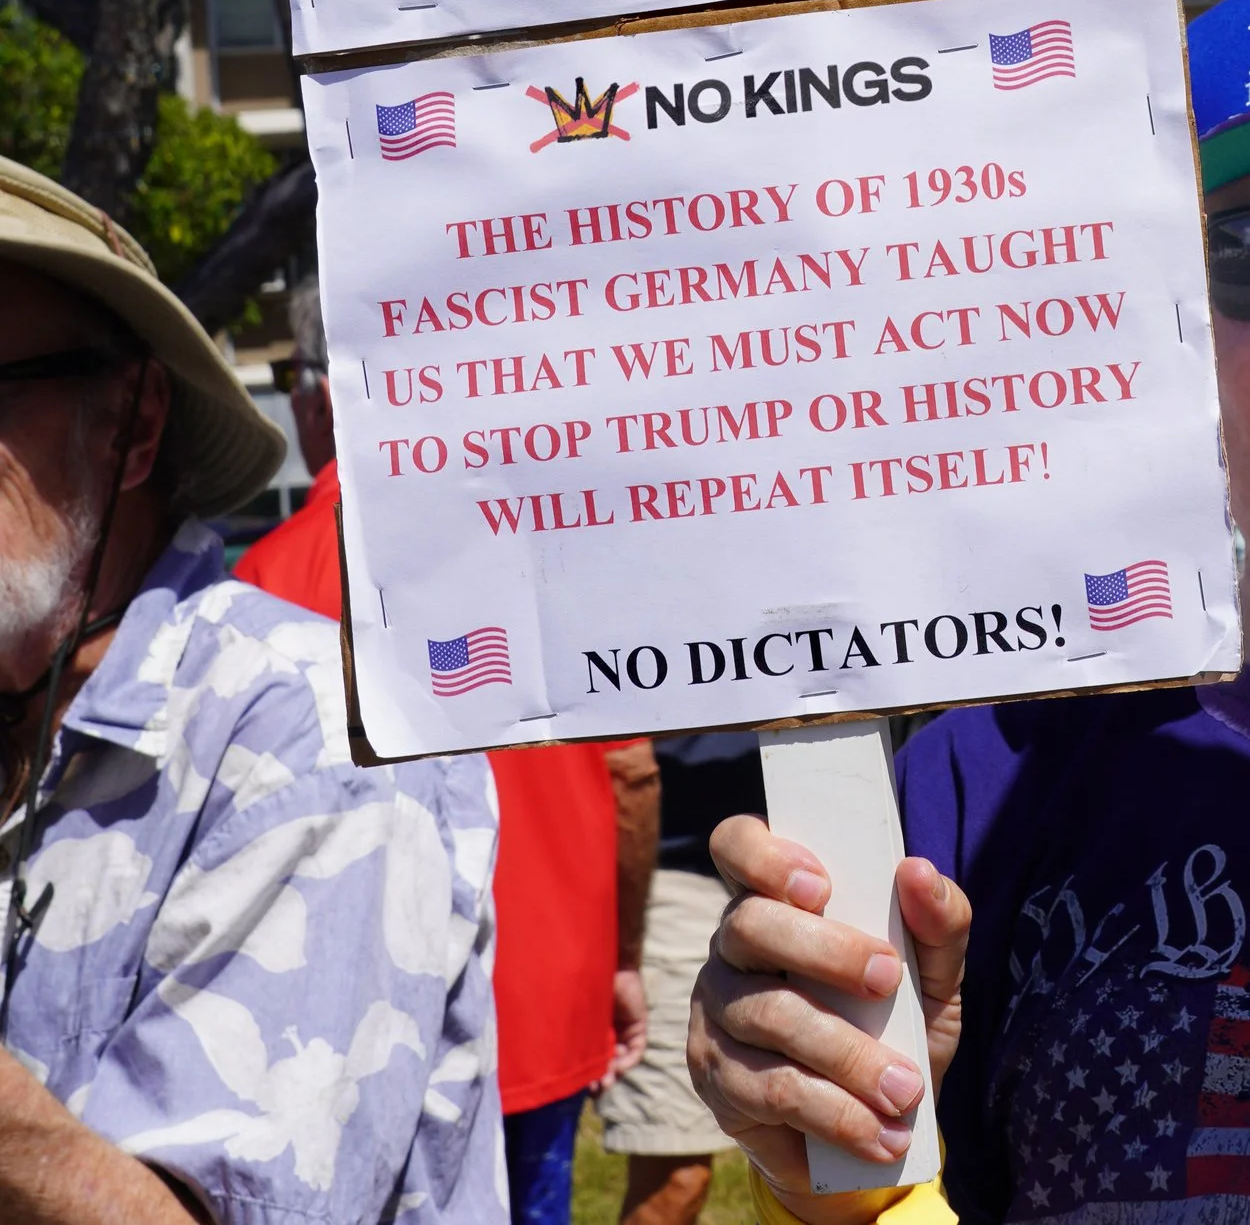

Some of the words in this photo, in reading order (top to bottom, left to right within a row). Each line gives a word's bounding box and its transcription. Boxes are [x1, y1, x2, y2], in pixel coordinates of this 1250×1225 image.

[645, 79, 731, 130] NO
[743, 57, 932, 118] KINGS
[446, 213, 552, 259] THE
[564, 184, 799, 246] HISTORY
[816, 175, 885, 216] OF
[903, 163, 1026, 208] 1930s
[377, 279, 588, 337] FASCIST
[605, 247, 870, 311] GERMANY
[886, 222, 1113, 281] TAUGHT
[382, 365, 443, 406] US
[457, 348, 595, 398] THAT
[610, 338, 693, 381] WE
[707, 320, 855, 372] MUST
[874, 307, 980, 355] ACT
[995, 292, 1126, 341] NOW
[379, 436, 448, 477] TO
[463, 421, 591, 469] STOP
[606, 400, 792, 453] TRUMP
[809, 391, 889, 432] OR
[899, 362, 1141, 423] HISTORY
[476, 489, 614, 536] WILL
[625, 466, 832, 522] REPEAT
[848, 442, 1050, 500] ITSELF!
[581, 646, 668, 694] NO
[684, 604, 1065, 685] DICTATORS!
